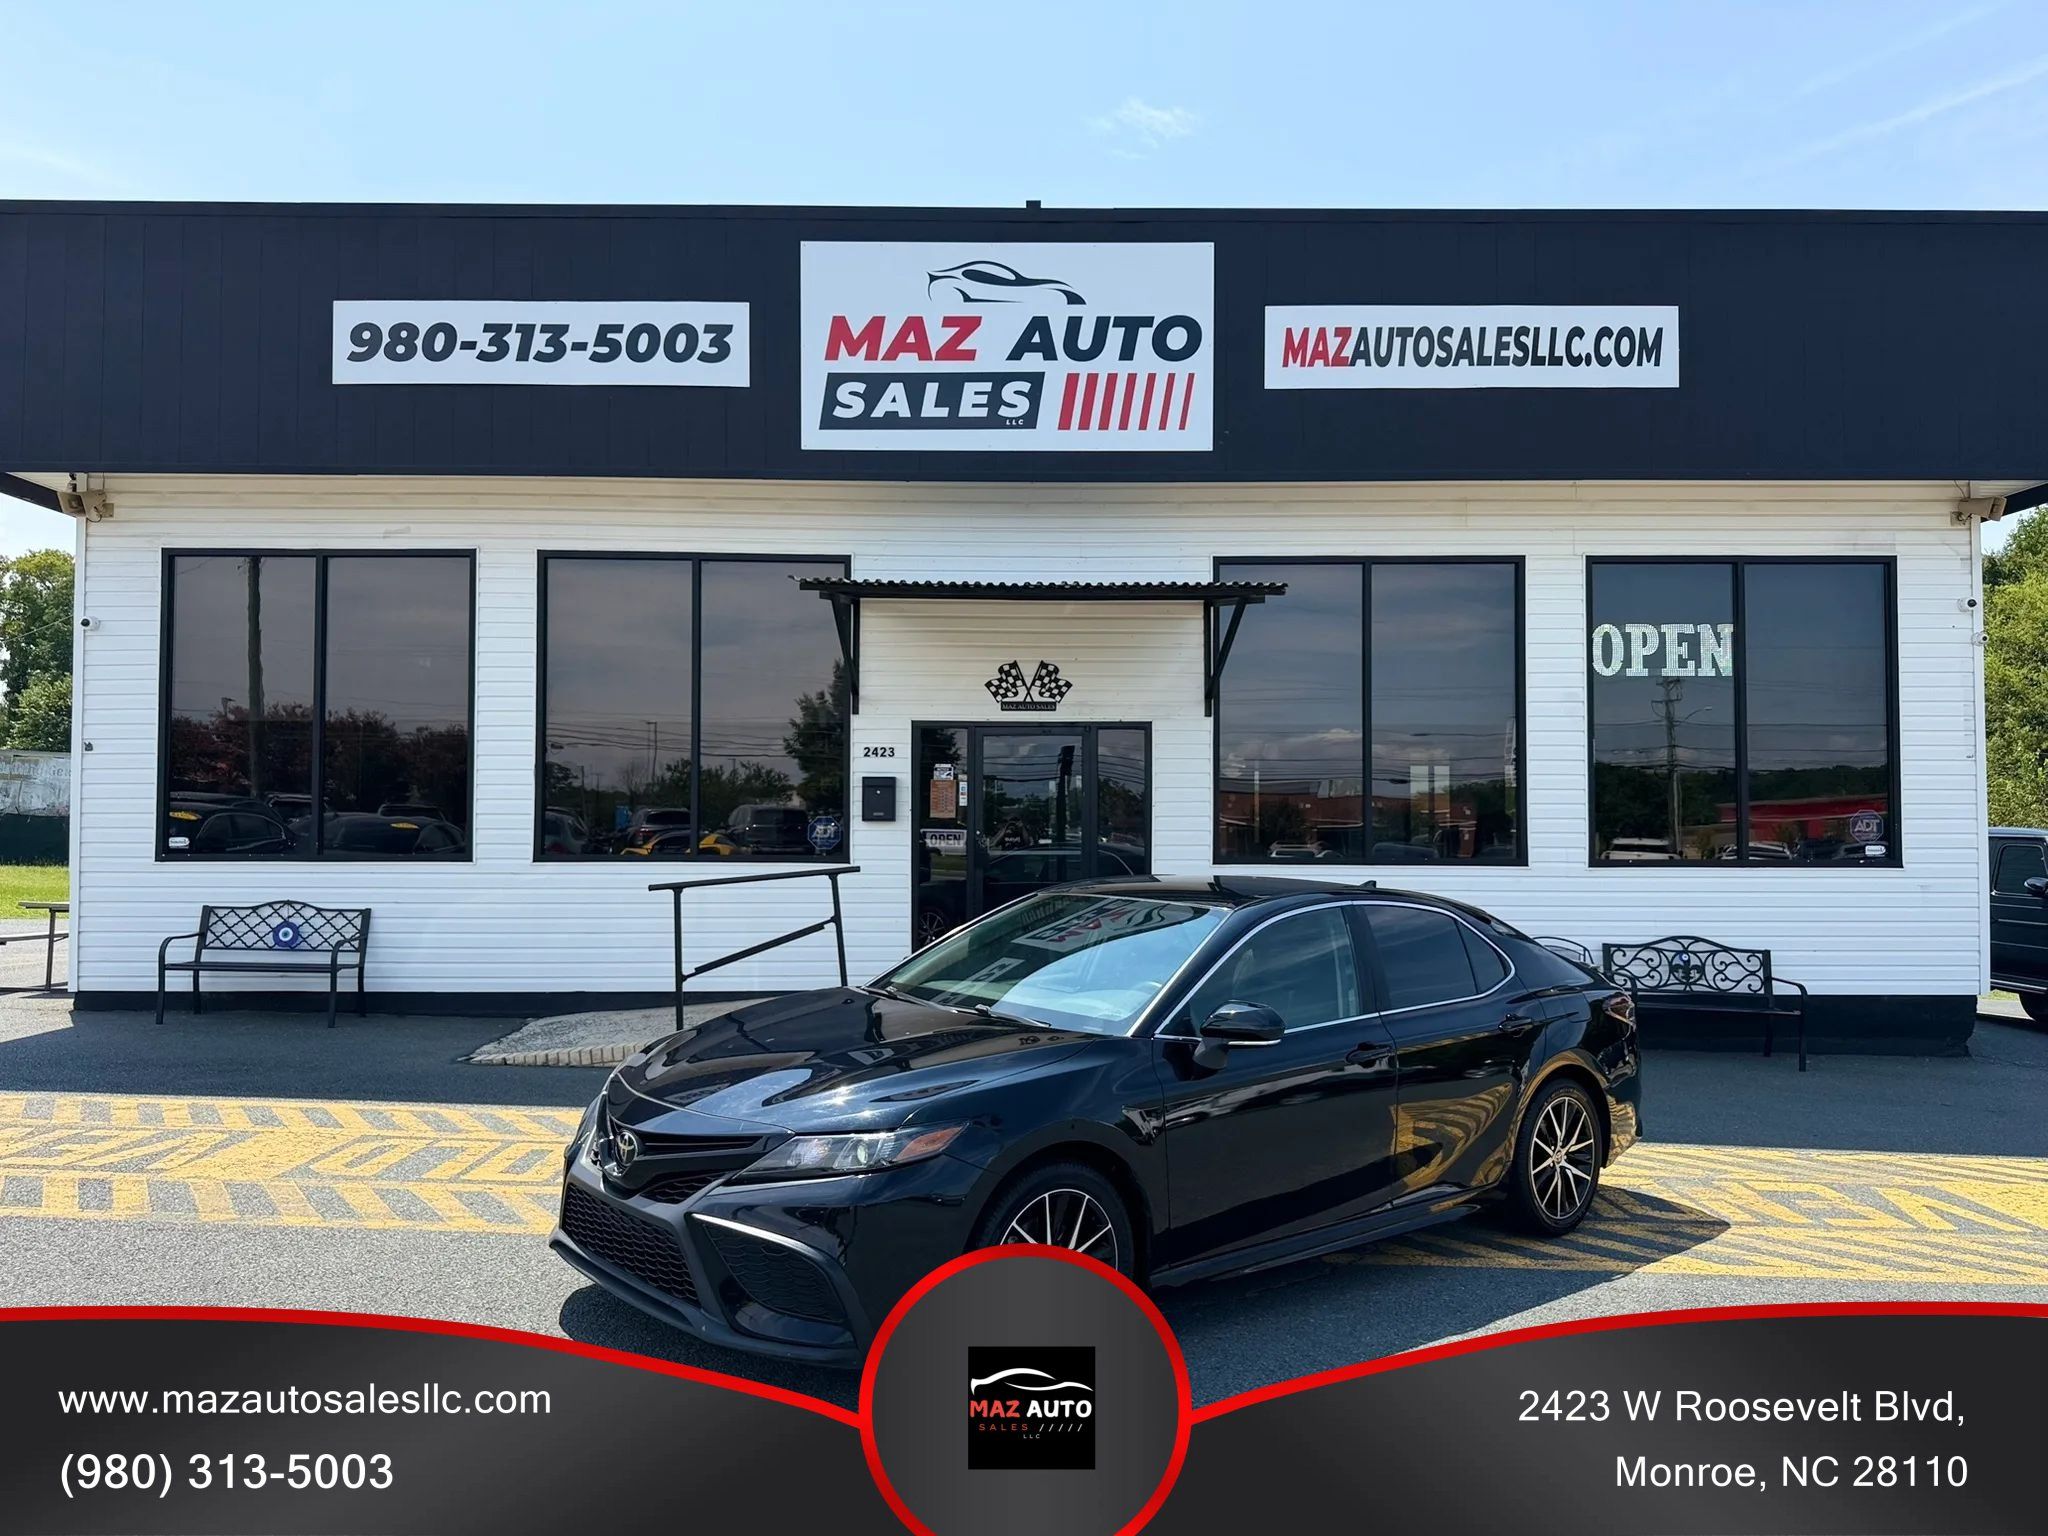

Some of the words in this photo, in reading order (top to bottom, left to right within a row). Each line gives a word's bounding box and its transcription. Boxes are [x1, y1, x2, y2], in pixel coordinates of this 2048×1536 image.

[346, 321, 734, 363] 980-313-5003
[824, 315, 983, 361] MAZ
[1005, 314, 1203, 363] AUTO
[1281, 325, 1664, 368] MAZAUTOSALESLLC.COM
[832, 380, 1032, 419] SALES
[1592, 623, 1734, 677] OPEN
[863, 746, 895, 758] 2423
[930, 833, 961, 846] OPEN
[1854, 819, 1880, 832] ADT
